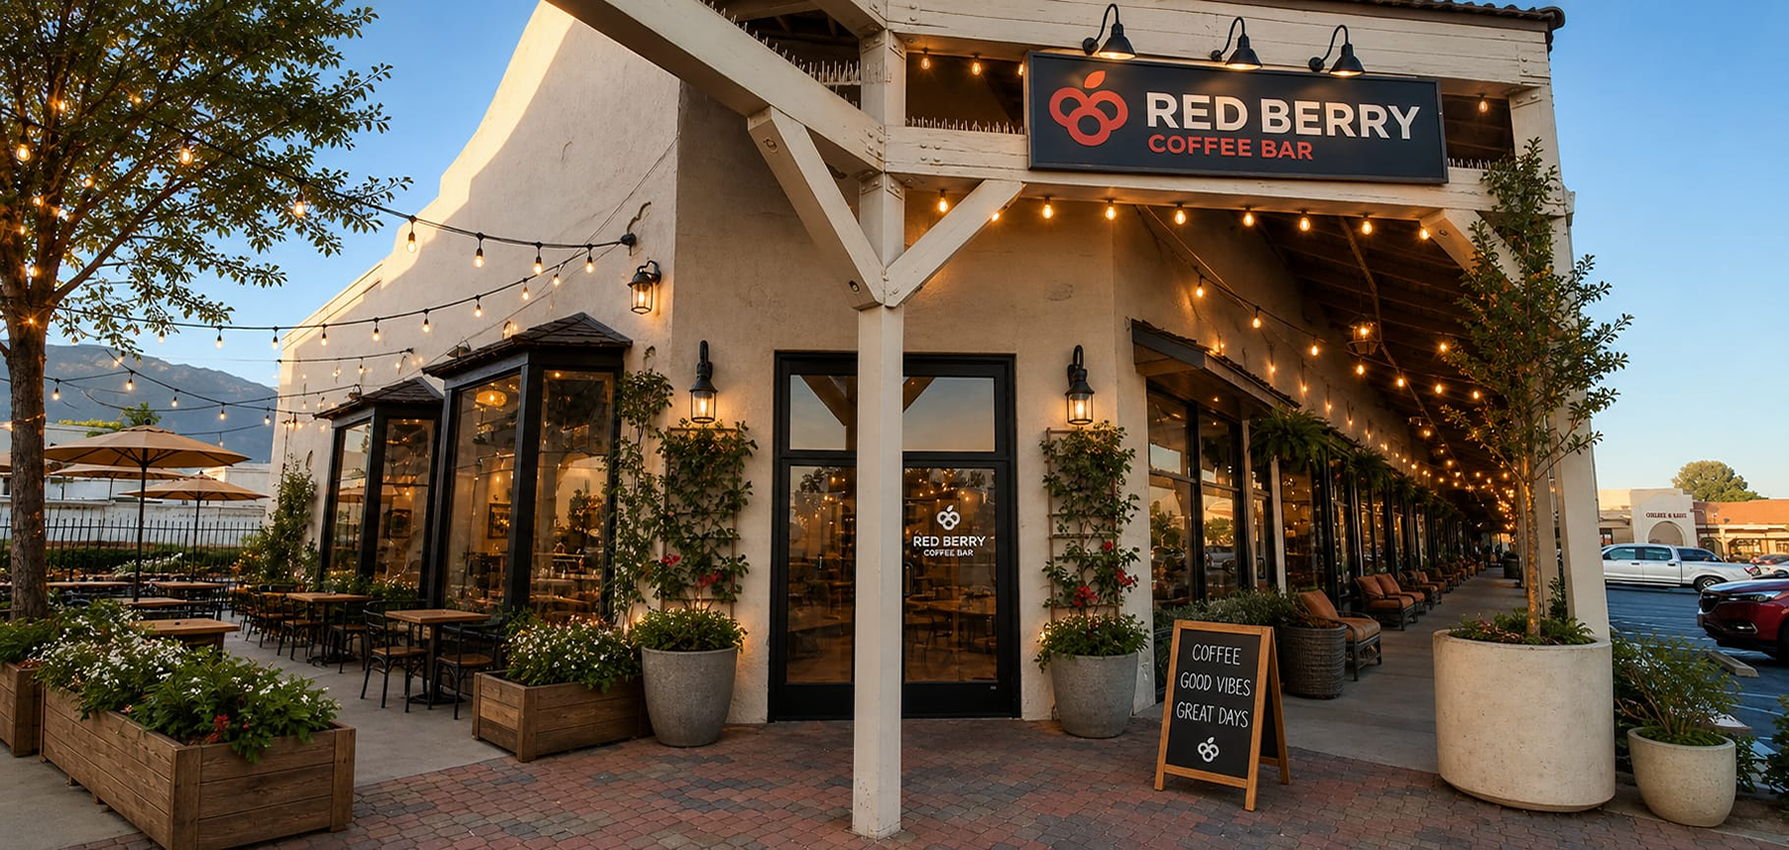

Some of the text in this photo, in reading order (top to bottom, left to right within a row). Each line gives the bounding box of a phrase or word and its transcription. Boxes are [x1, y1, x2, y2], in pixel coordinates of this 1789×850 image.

[1146, 92, 1420, 140] RED BERRY
[1148, 134, 1313, 161] COFFEE BAR
[913, 535, 986, 547] RED BERRY
[923, 549, 974, 557] COFFEE BAR
[1192, 643, 1241, 665] COFFEE
[1180, 671, 1251, 697] GOOD VIBES
[1176, 701, 1249, 728] GREAT DAYS
